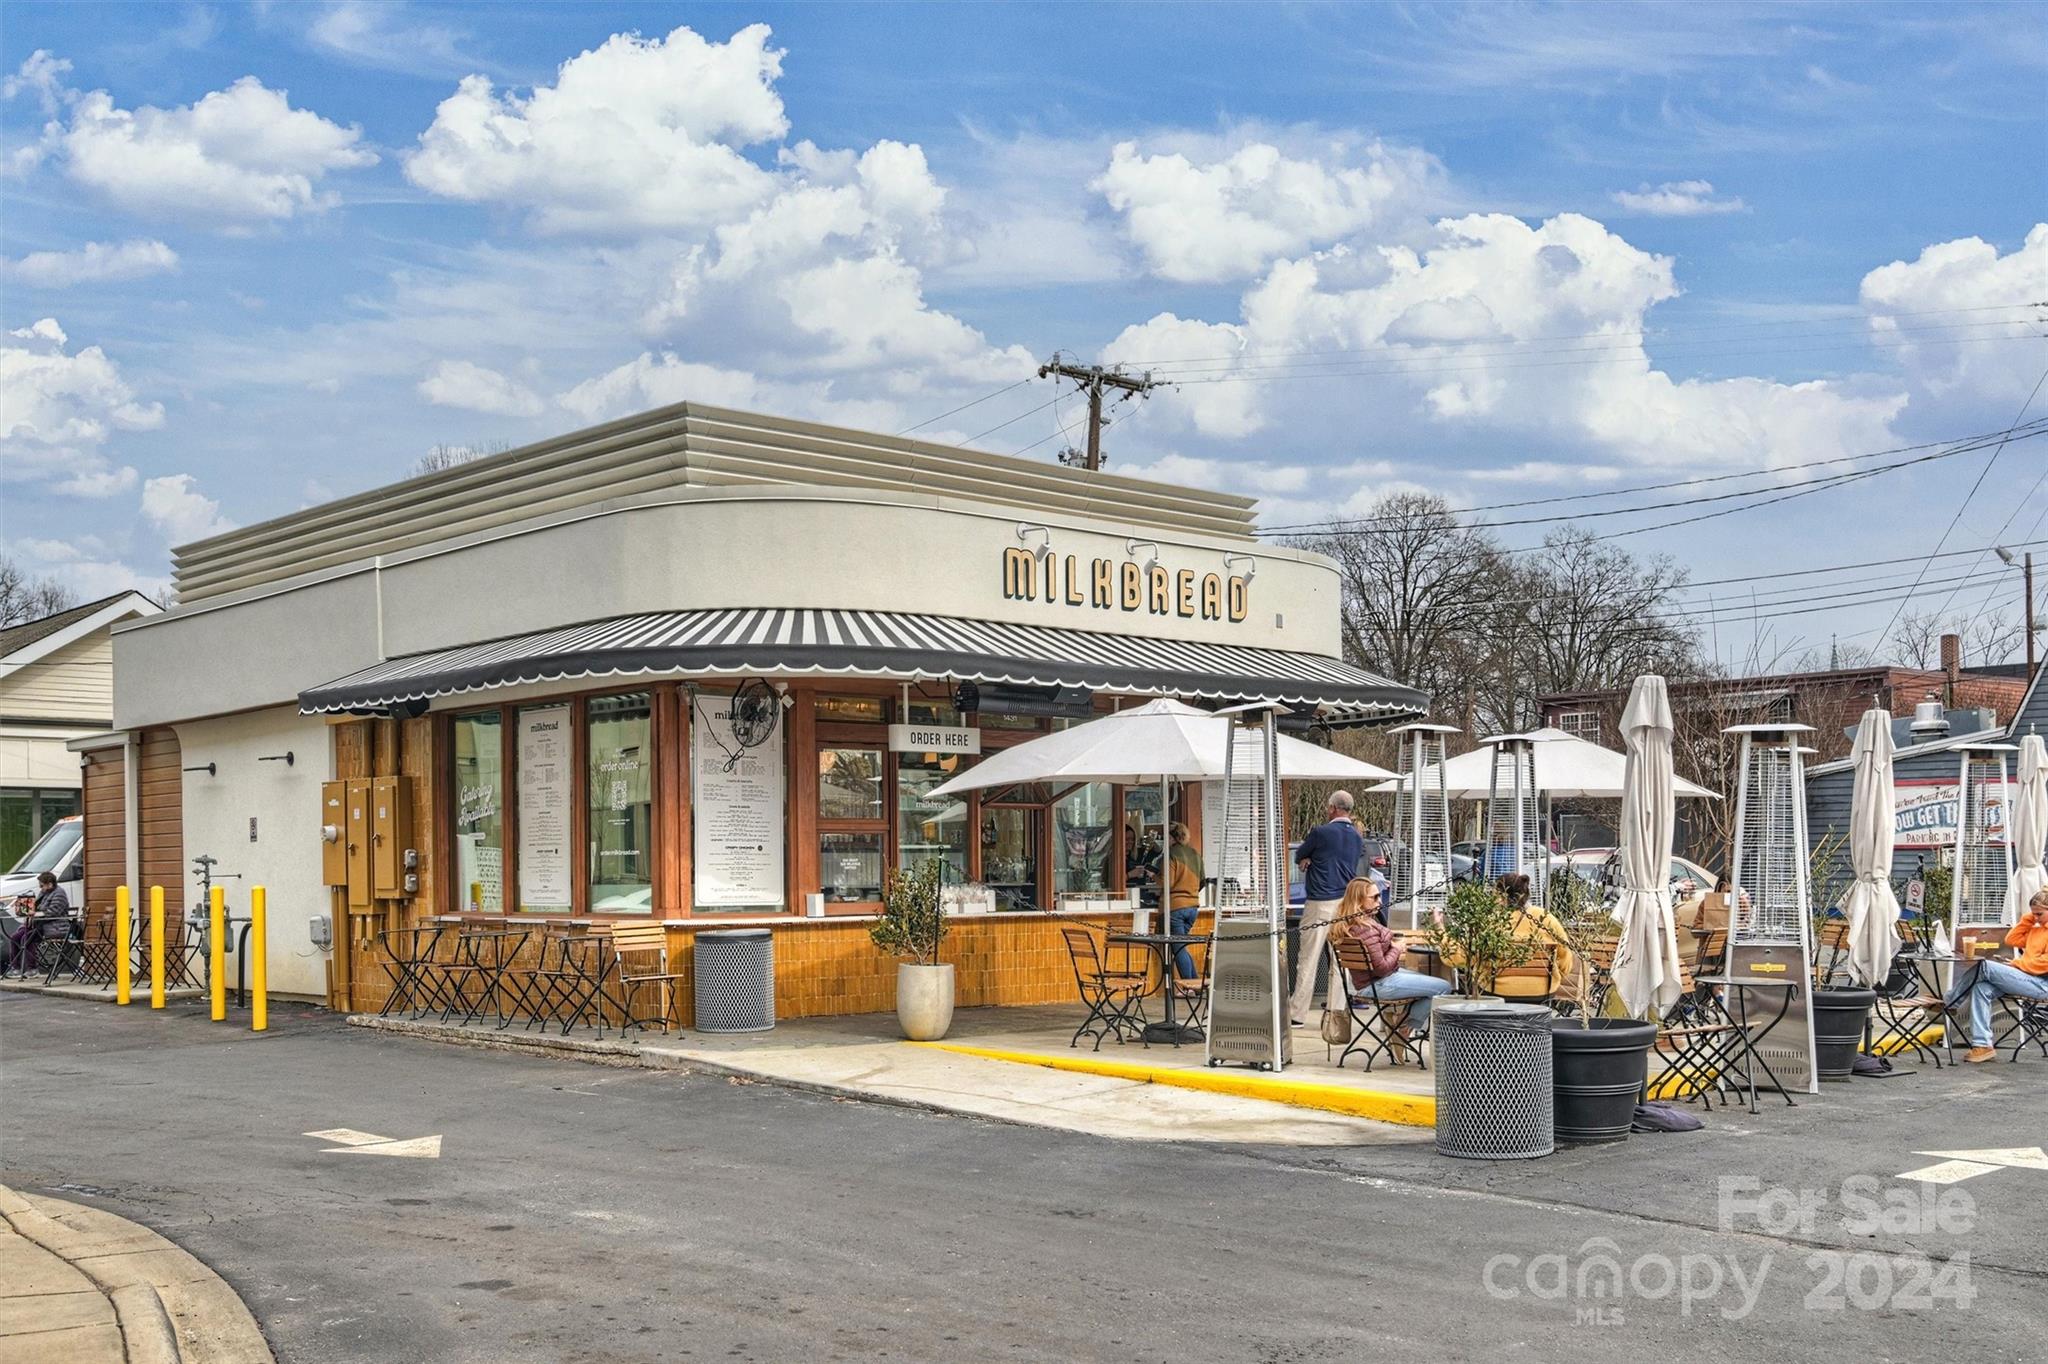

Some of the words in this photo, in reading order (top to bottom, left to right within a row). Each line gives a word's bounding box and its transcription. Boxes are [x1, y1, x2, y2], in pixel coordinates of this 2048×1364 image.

[1003, 546, 1248, 624] MILKBREAD
[910, 731, 941, 745] ORDER
[945, 733, 969, 747] HERE
[600, 761, 618, 772] order
[618, 759, 640, 771] online
[915, 800, 951, 809] milkbread
[1895, 811, 1915, 832] OW
[1917, 804, 1941, 826] GET
